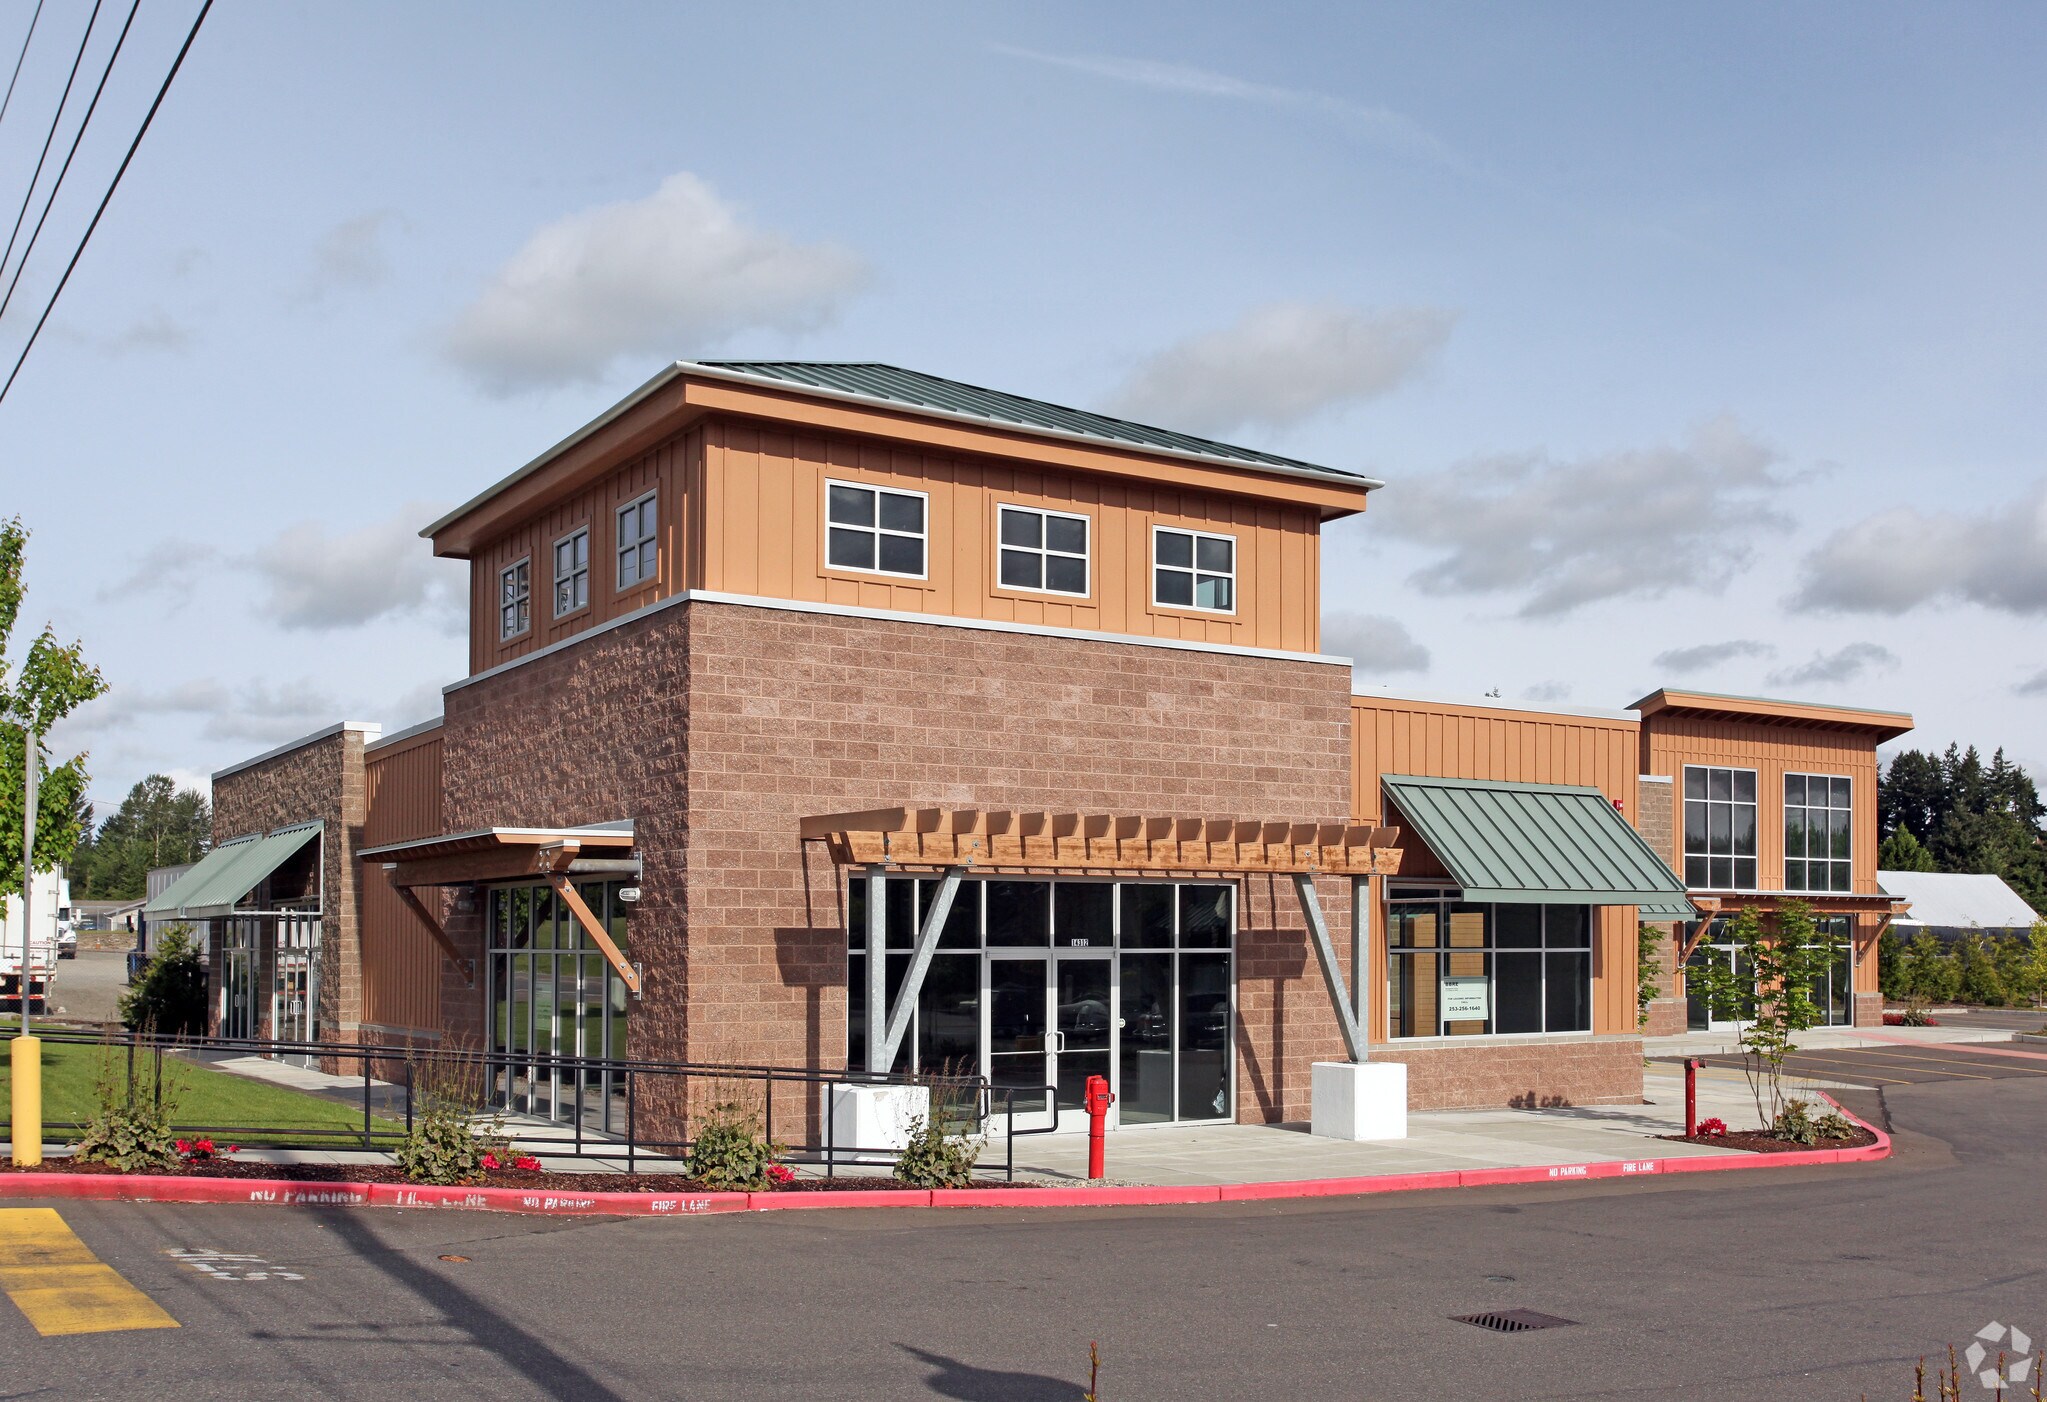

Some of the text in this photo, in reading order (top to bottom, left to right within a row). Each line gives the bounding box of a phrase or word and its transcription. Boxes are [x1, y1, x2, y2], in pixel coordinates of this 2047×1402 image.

[1549, 1166, 1587, 1177] NO PARKING
[1623, 1162, 1654, 1172] FIRE LANE
[681, 1199, 711, 1212] LANE
